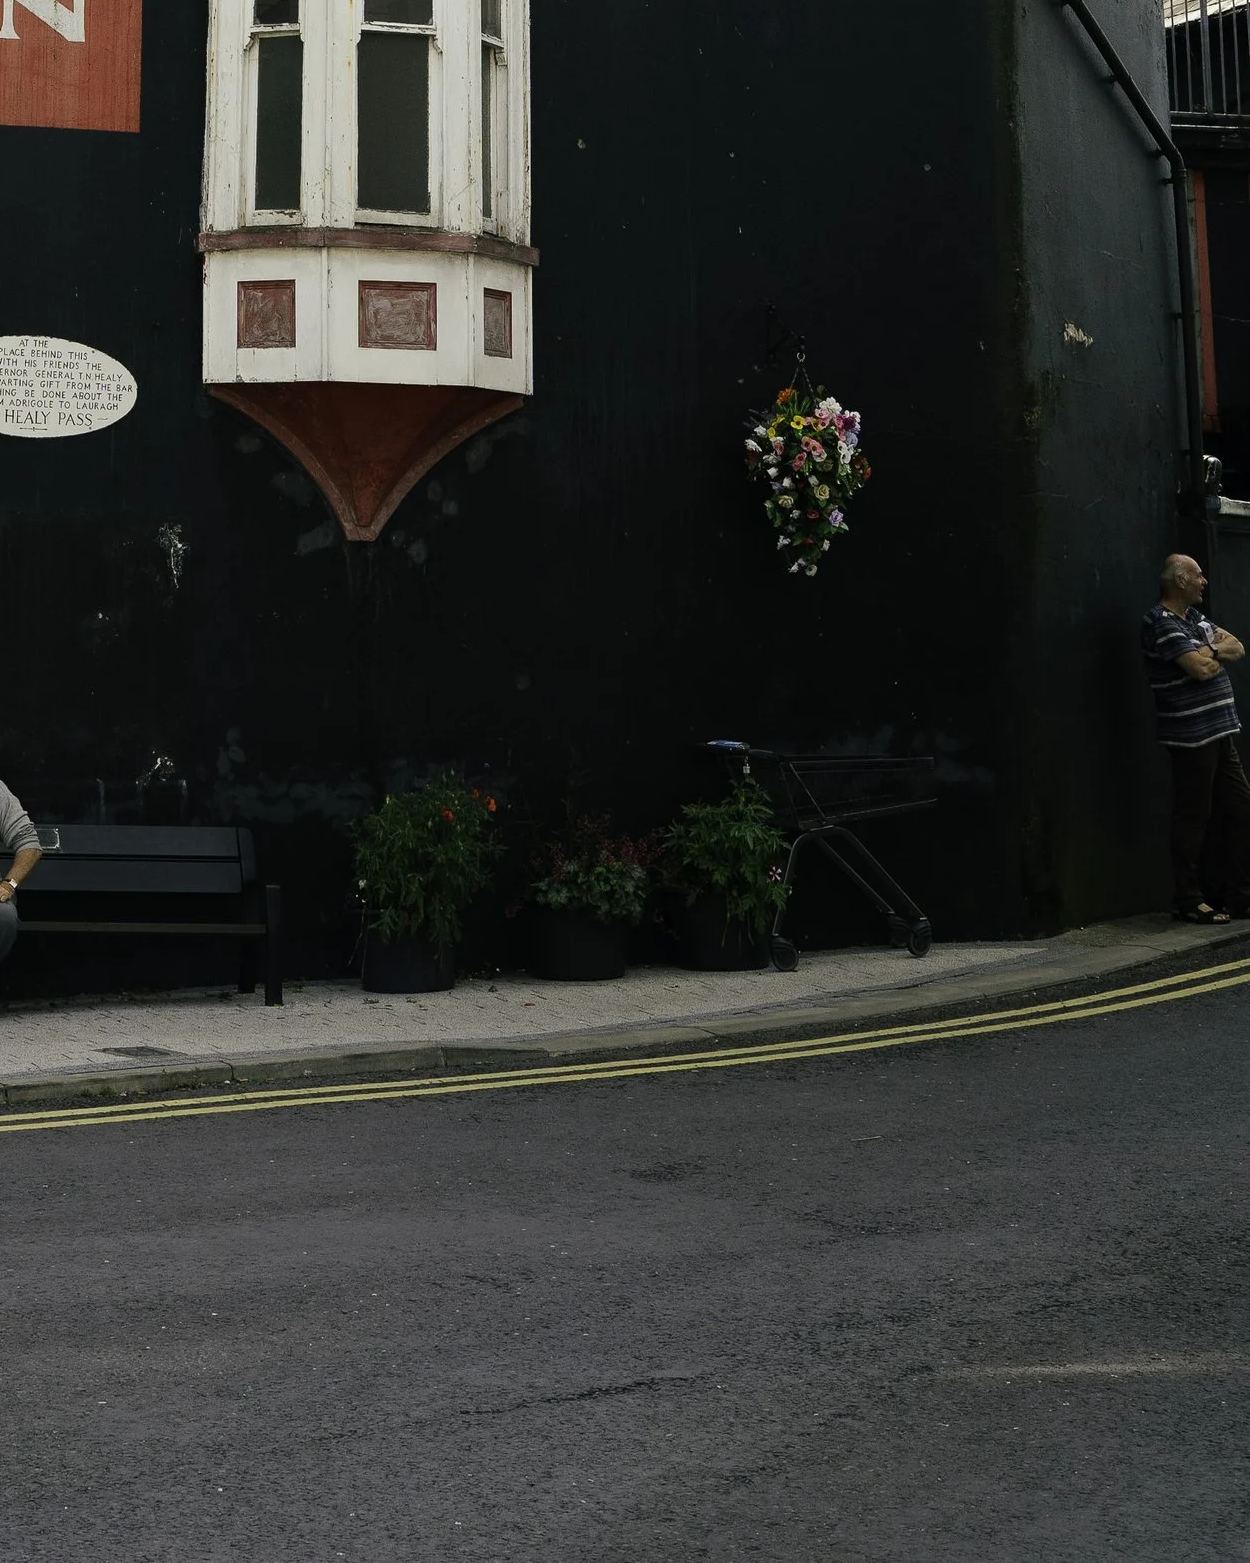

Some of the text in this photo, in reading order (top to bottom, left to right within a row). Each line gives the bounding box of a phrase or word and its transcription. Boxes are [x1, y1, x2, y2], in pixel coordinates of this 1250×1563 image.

[18, 339, 49, 348] AT THE
[30, 349, 62, 359] BEHIND
[68, 351, 88, 361] THIS
[24, 359, 37, 368] HIS
[43, 360, 80, 370] FRIENDS
[85, 362, 102, 371] THE
[35, 370, 75, 380] GENERAL
[40, 380, 60, 389] GIFT
[66, 382, 91, 390] FROM
[96, 383, 112, 391] THE
[116, 384, 133, 393] BAR
[24, 389, 35, 398] BE
[42, 390, 66, 399] DONE
[72, 392, 102, 401] ABOUT
[107, 393, 123, 402] THE
[9, 399, 54, 409] ADRIGOLE
[59, 400, 71, 409] TO
[76, 401, 119, 411] LAURAGH
[4, 409, 51, 425] HEALY
[58, 412, 93, 427] PASS
